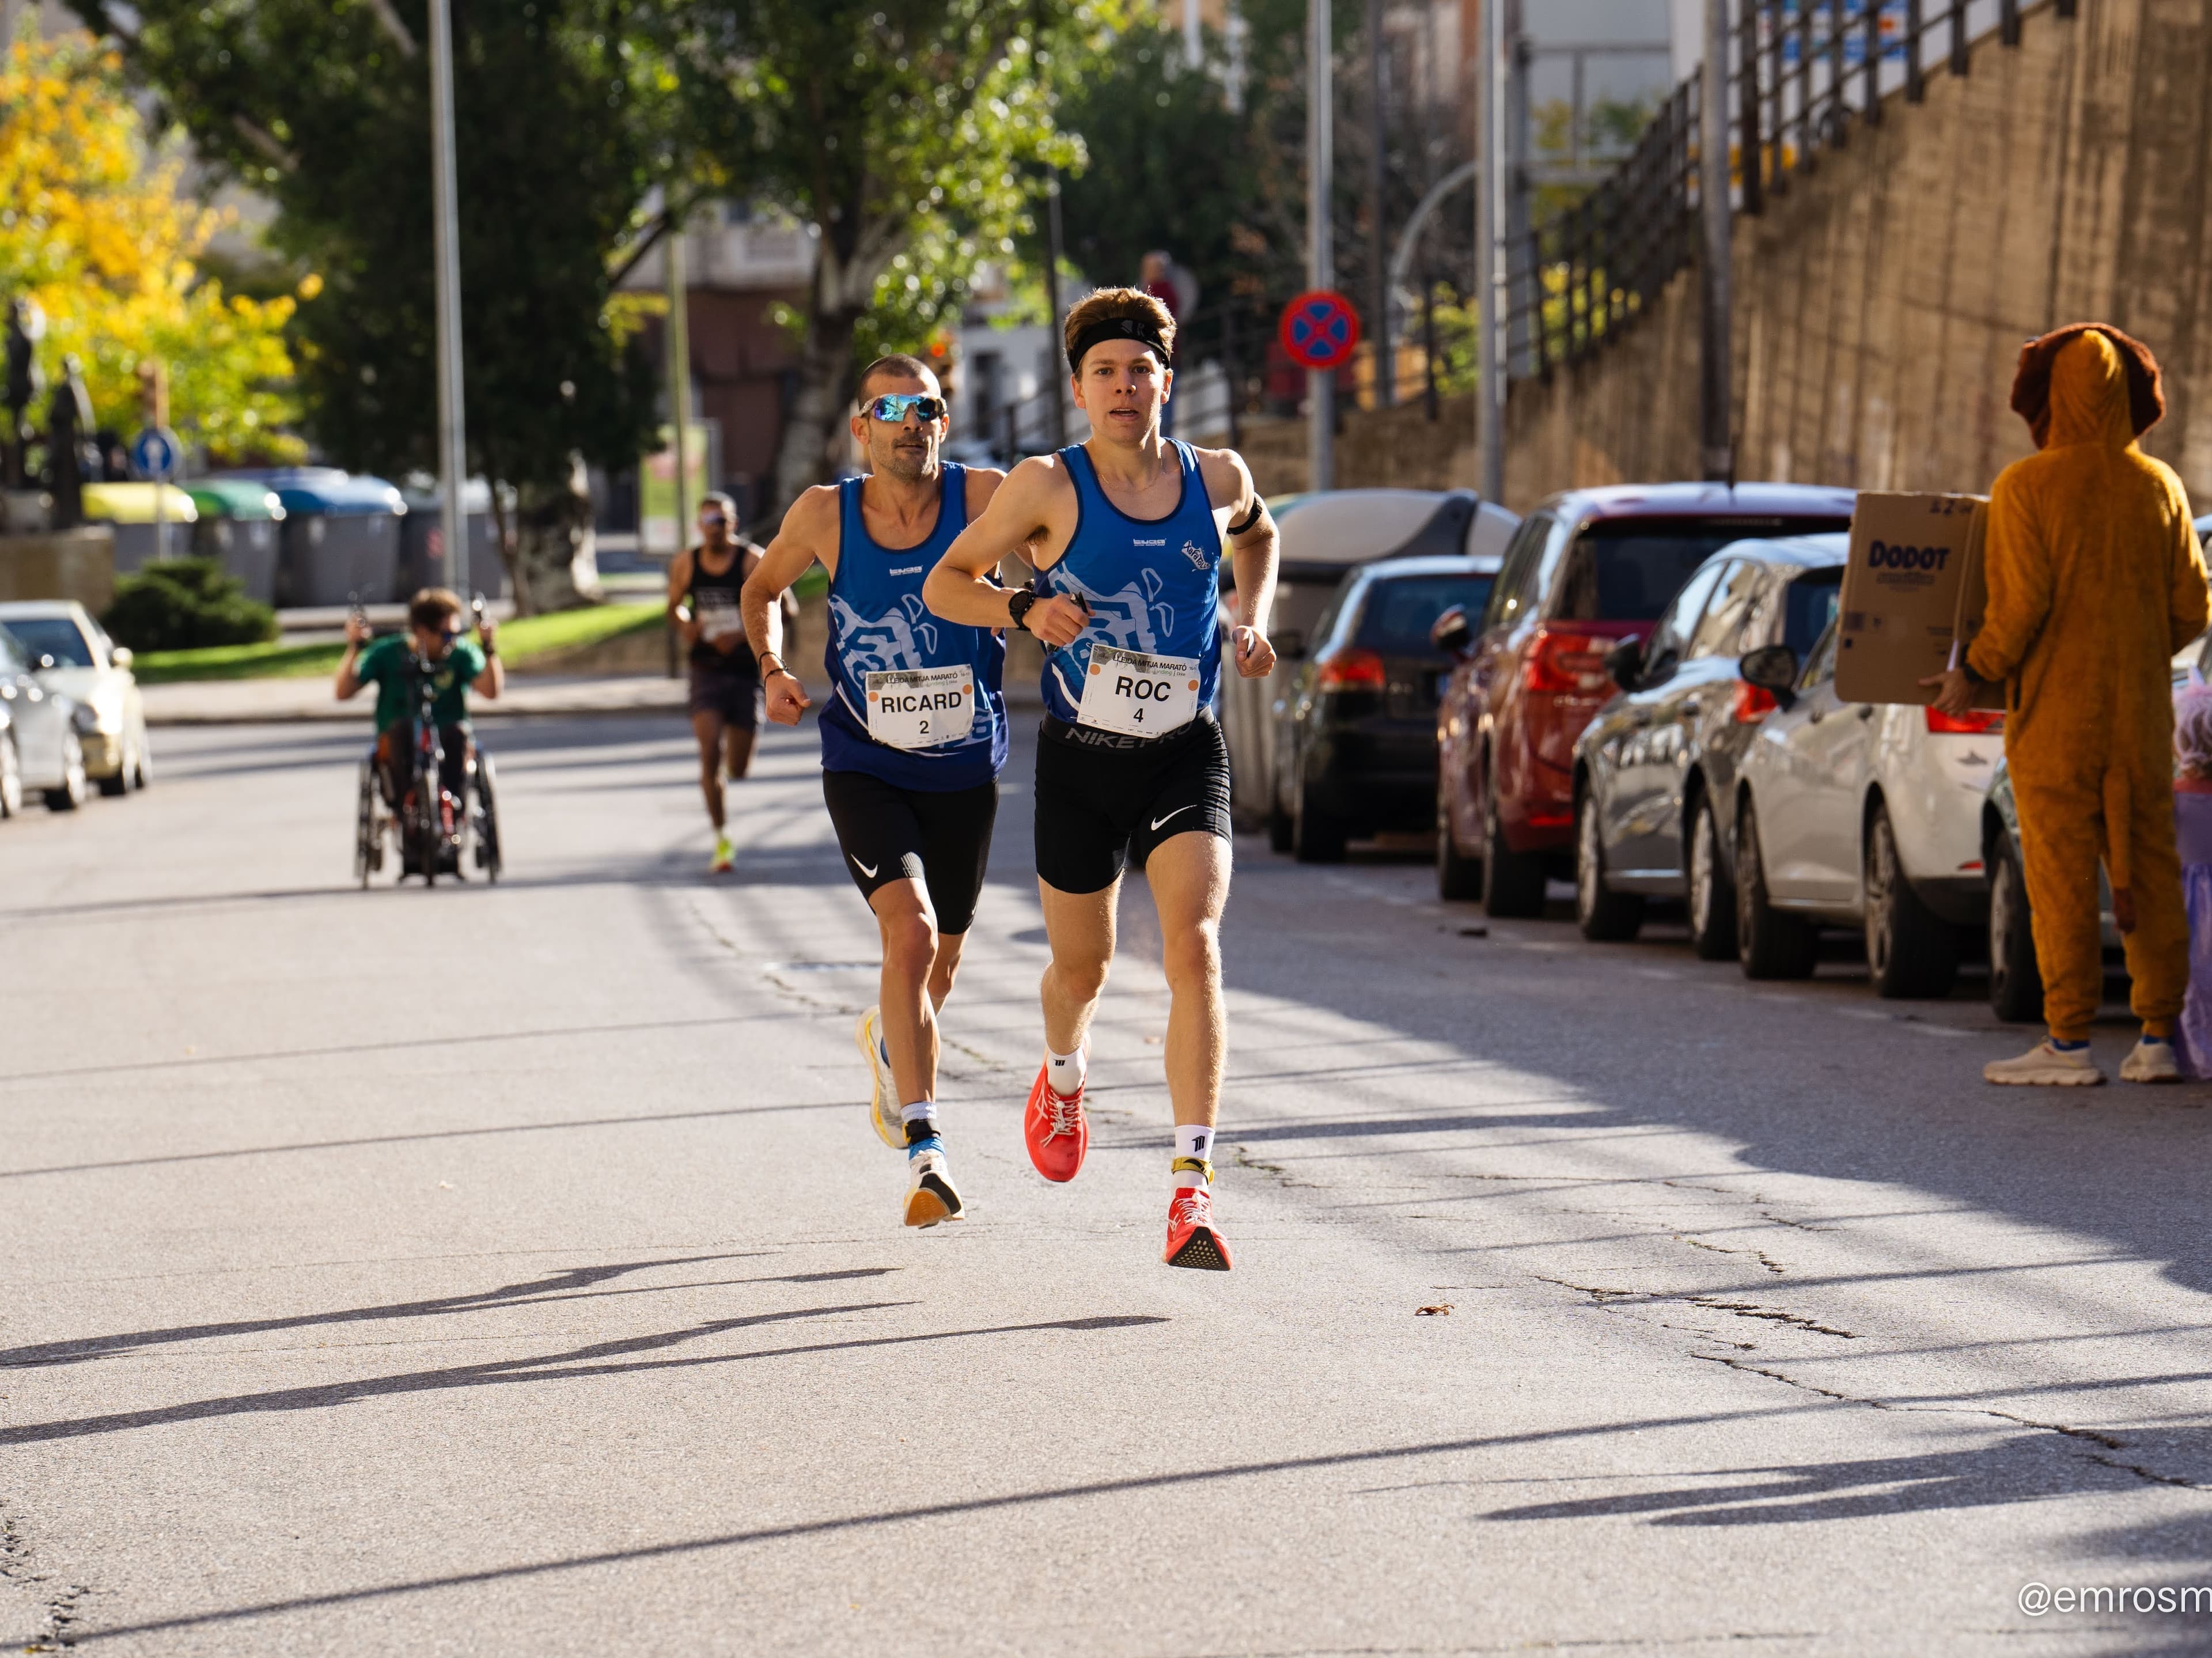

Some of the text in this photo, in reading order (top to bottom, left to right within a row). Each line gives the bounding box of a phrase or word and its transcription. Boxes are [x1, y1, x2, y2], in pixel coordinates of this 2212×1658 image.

[1869, 540, 1950, 570] DODOT
[1113, 655, 1187, 671] LLEIDA MITJA MARATÓ
[931, 672, 957, 680] MARATÓ
[1115, 676, 1171, 702] ROC
[881, 692, 962, 713] RICARD
[1133, 708, 1143, 722] 4
[919, 720, 929, 734] 2
[1065, 728, 1135, 748] NIKE
